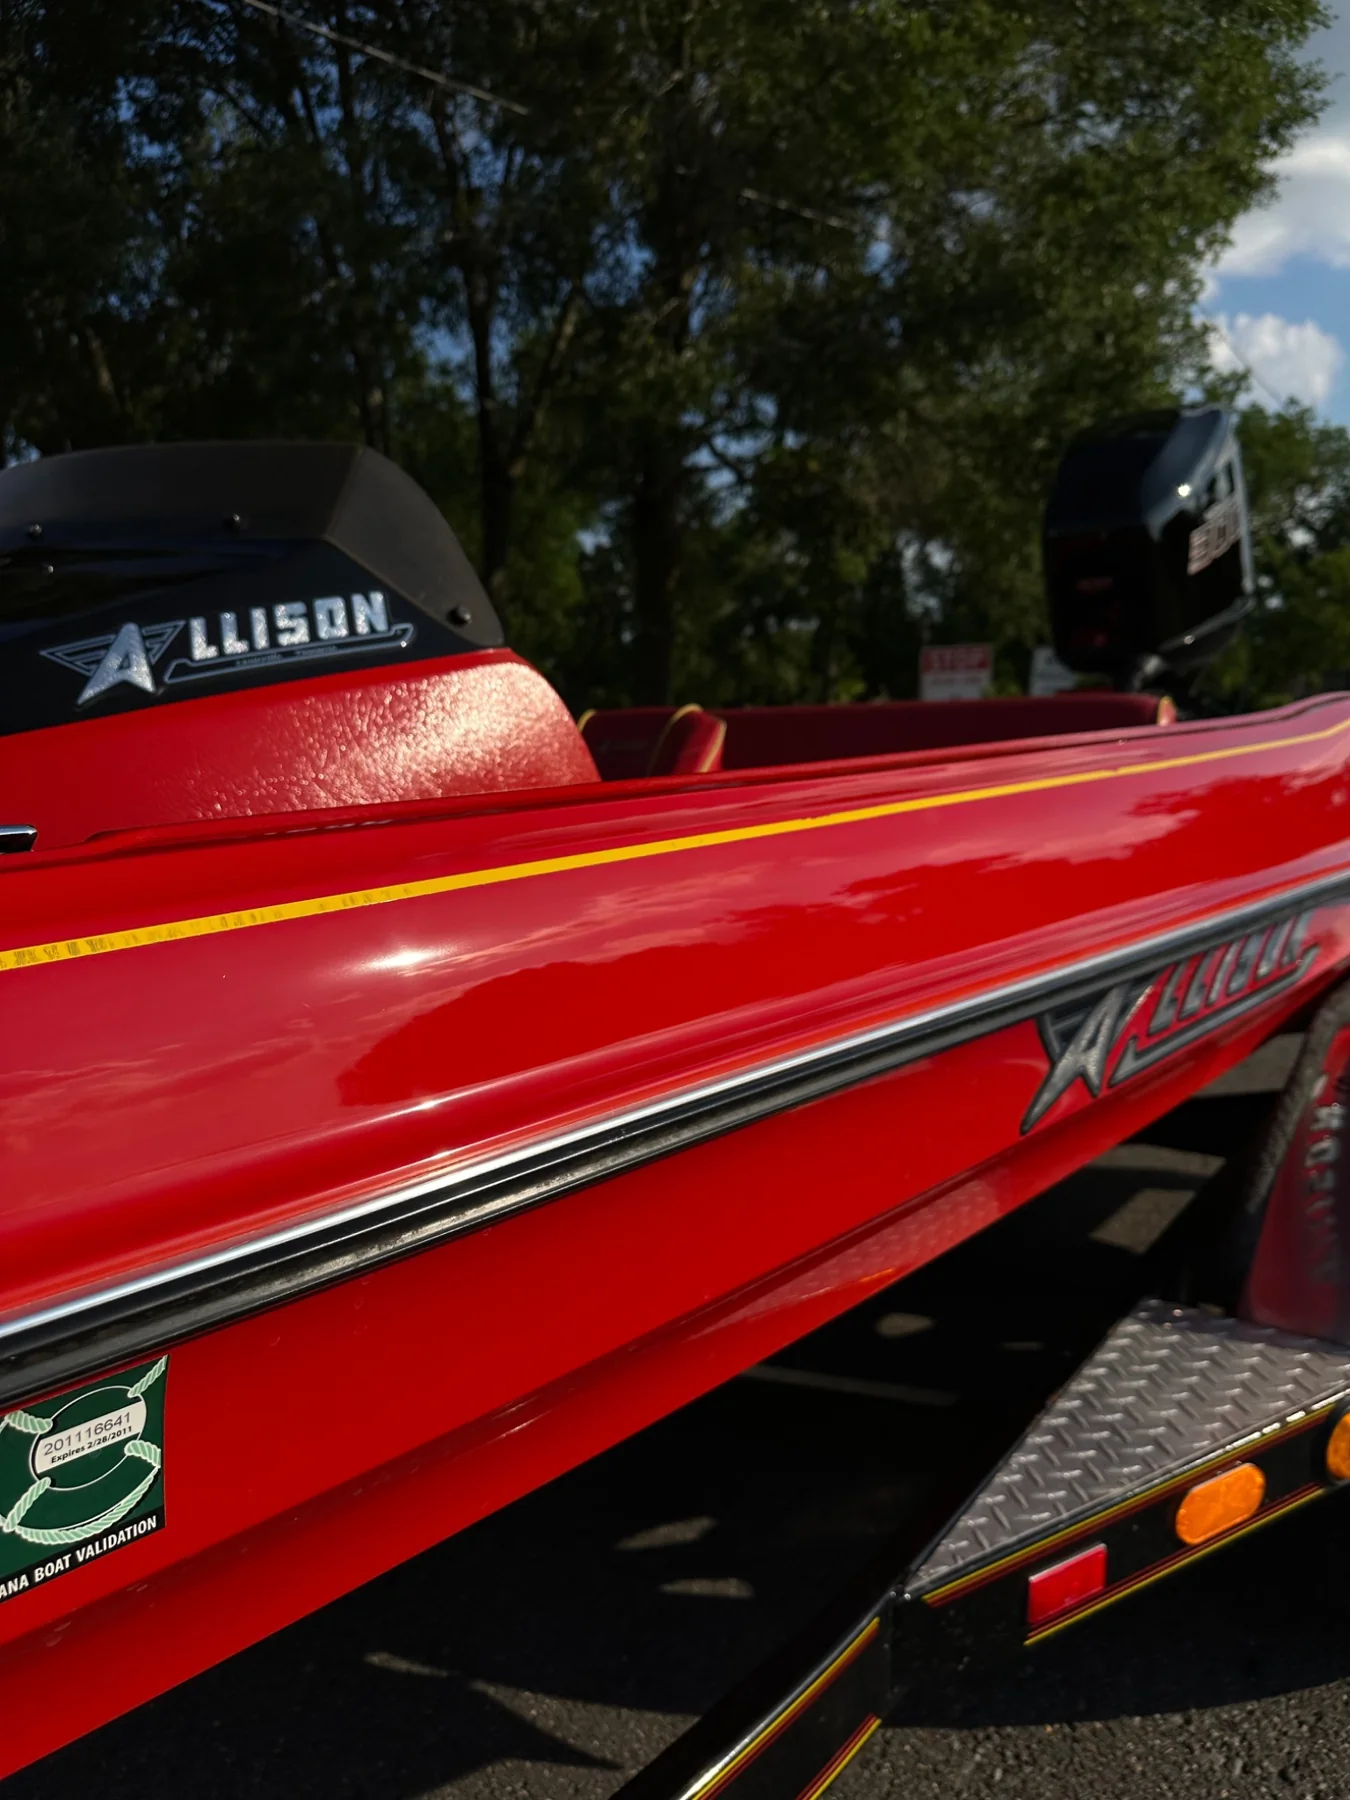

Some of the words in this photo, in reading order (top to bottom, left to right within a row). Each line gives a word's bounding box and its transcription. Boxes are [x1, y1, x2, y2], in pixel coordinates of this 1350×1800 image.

[76, 591, 390, 705] ALLISON
[43, 1411, 131, 1456] 201116641
[51, 1445, 85, 1464] Expires
[87, 1425, 132, 1449] 2/28/2011
[34, 1554, 72, 1583] BOAT
[75, 1515, 157, 1562] VALIDATION
